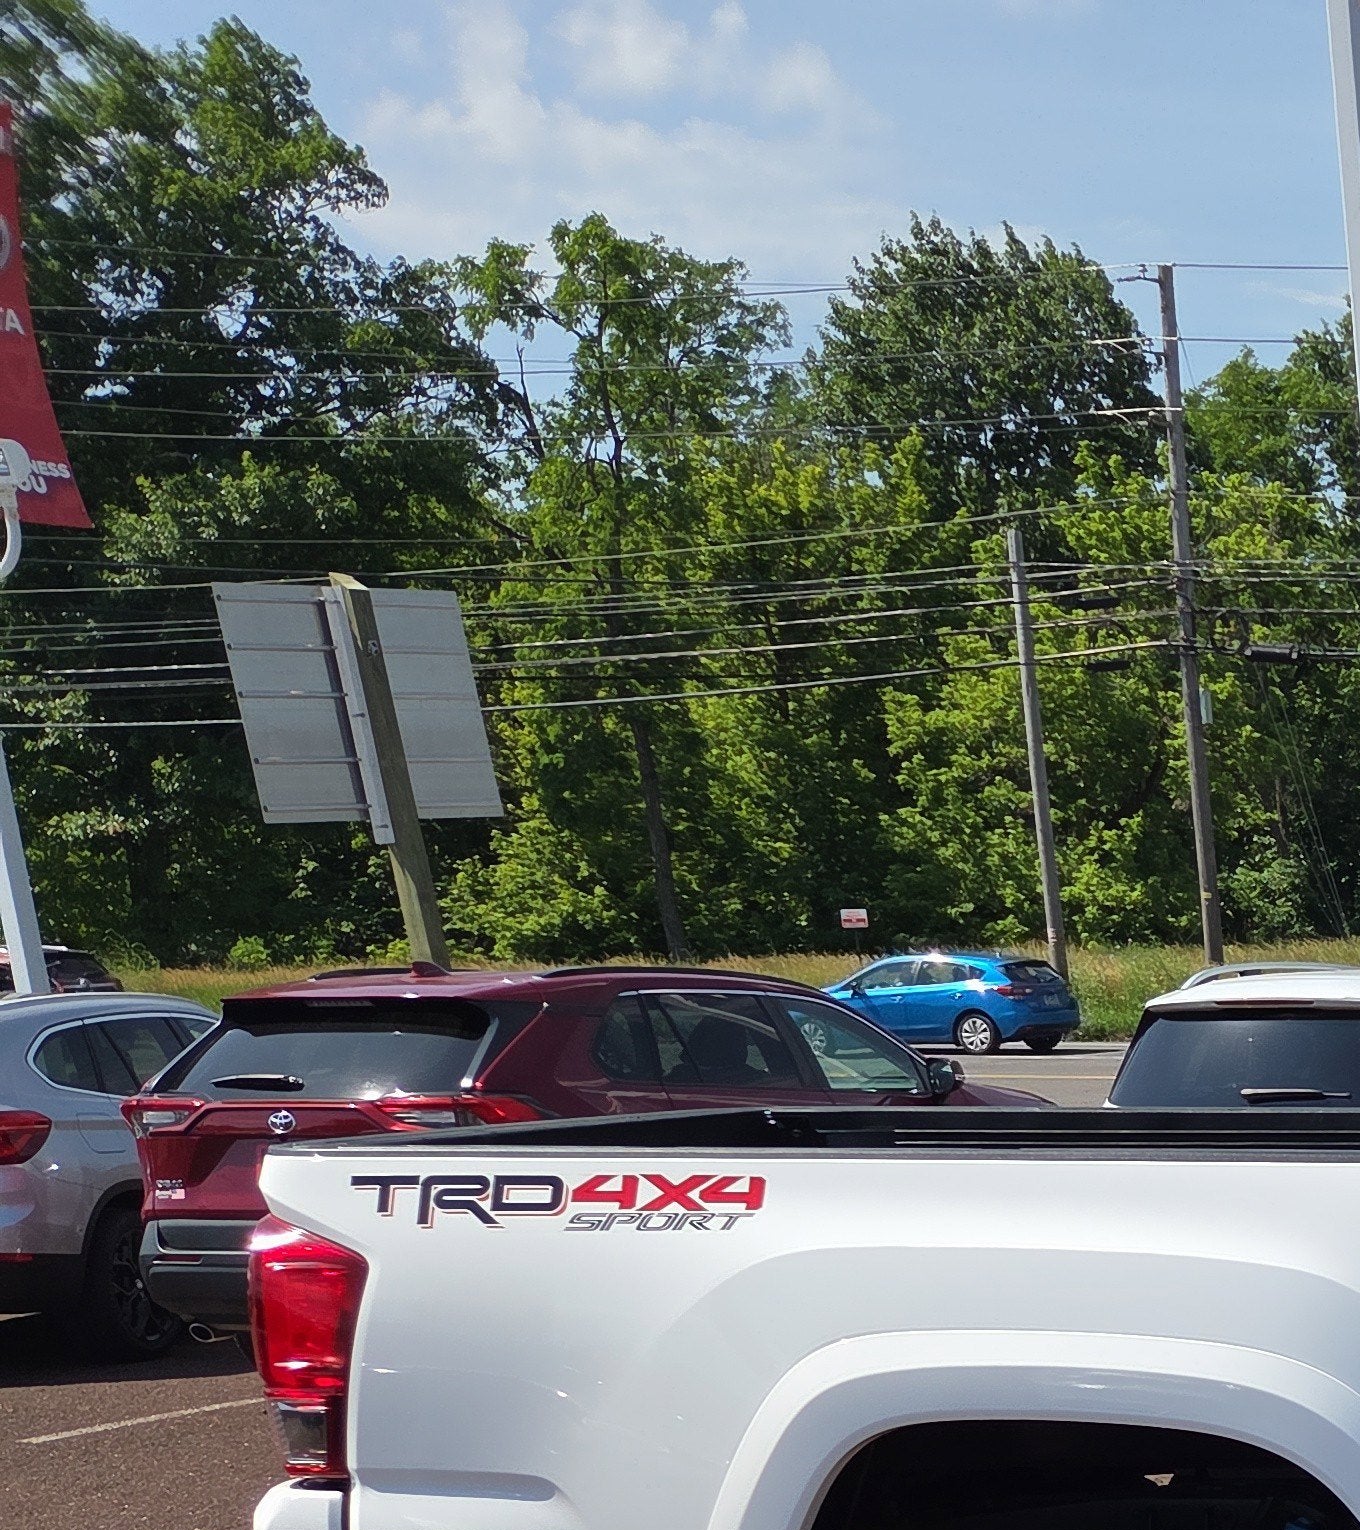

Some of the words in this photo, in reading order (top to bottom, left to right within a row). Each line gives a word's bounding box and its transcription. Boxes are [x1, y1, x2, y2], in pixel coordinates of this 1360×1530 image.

[349, 1174, 570, 1230] TRD
[569, 1173, 768, 1212] 4X4
[562, 1211, 757, 1232] SPORT
